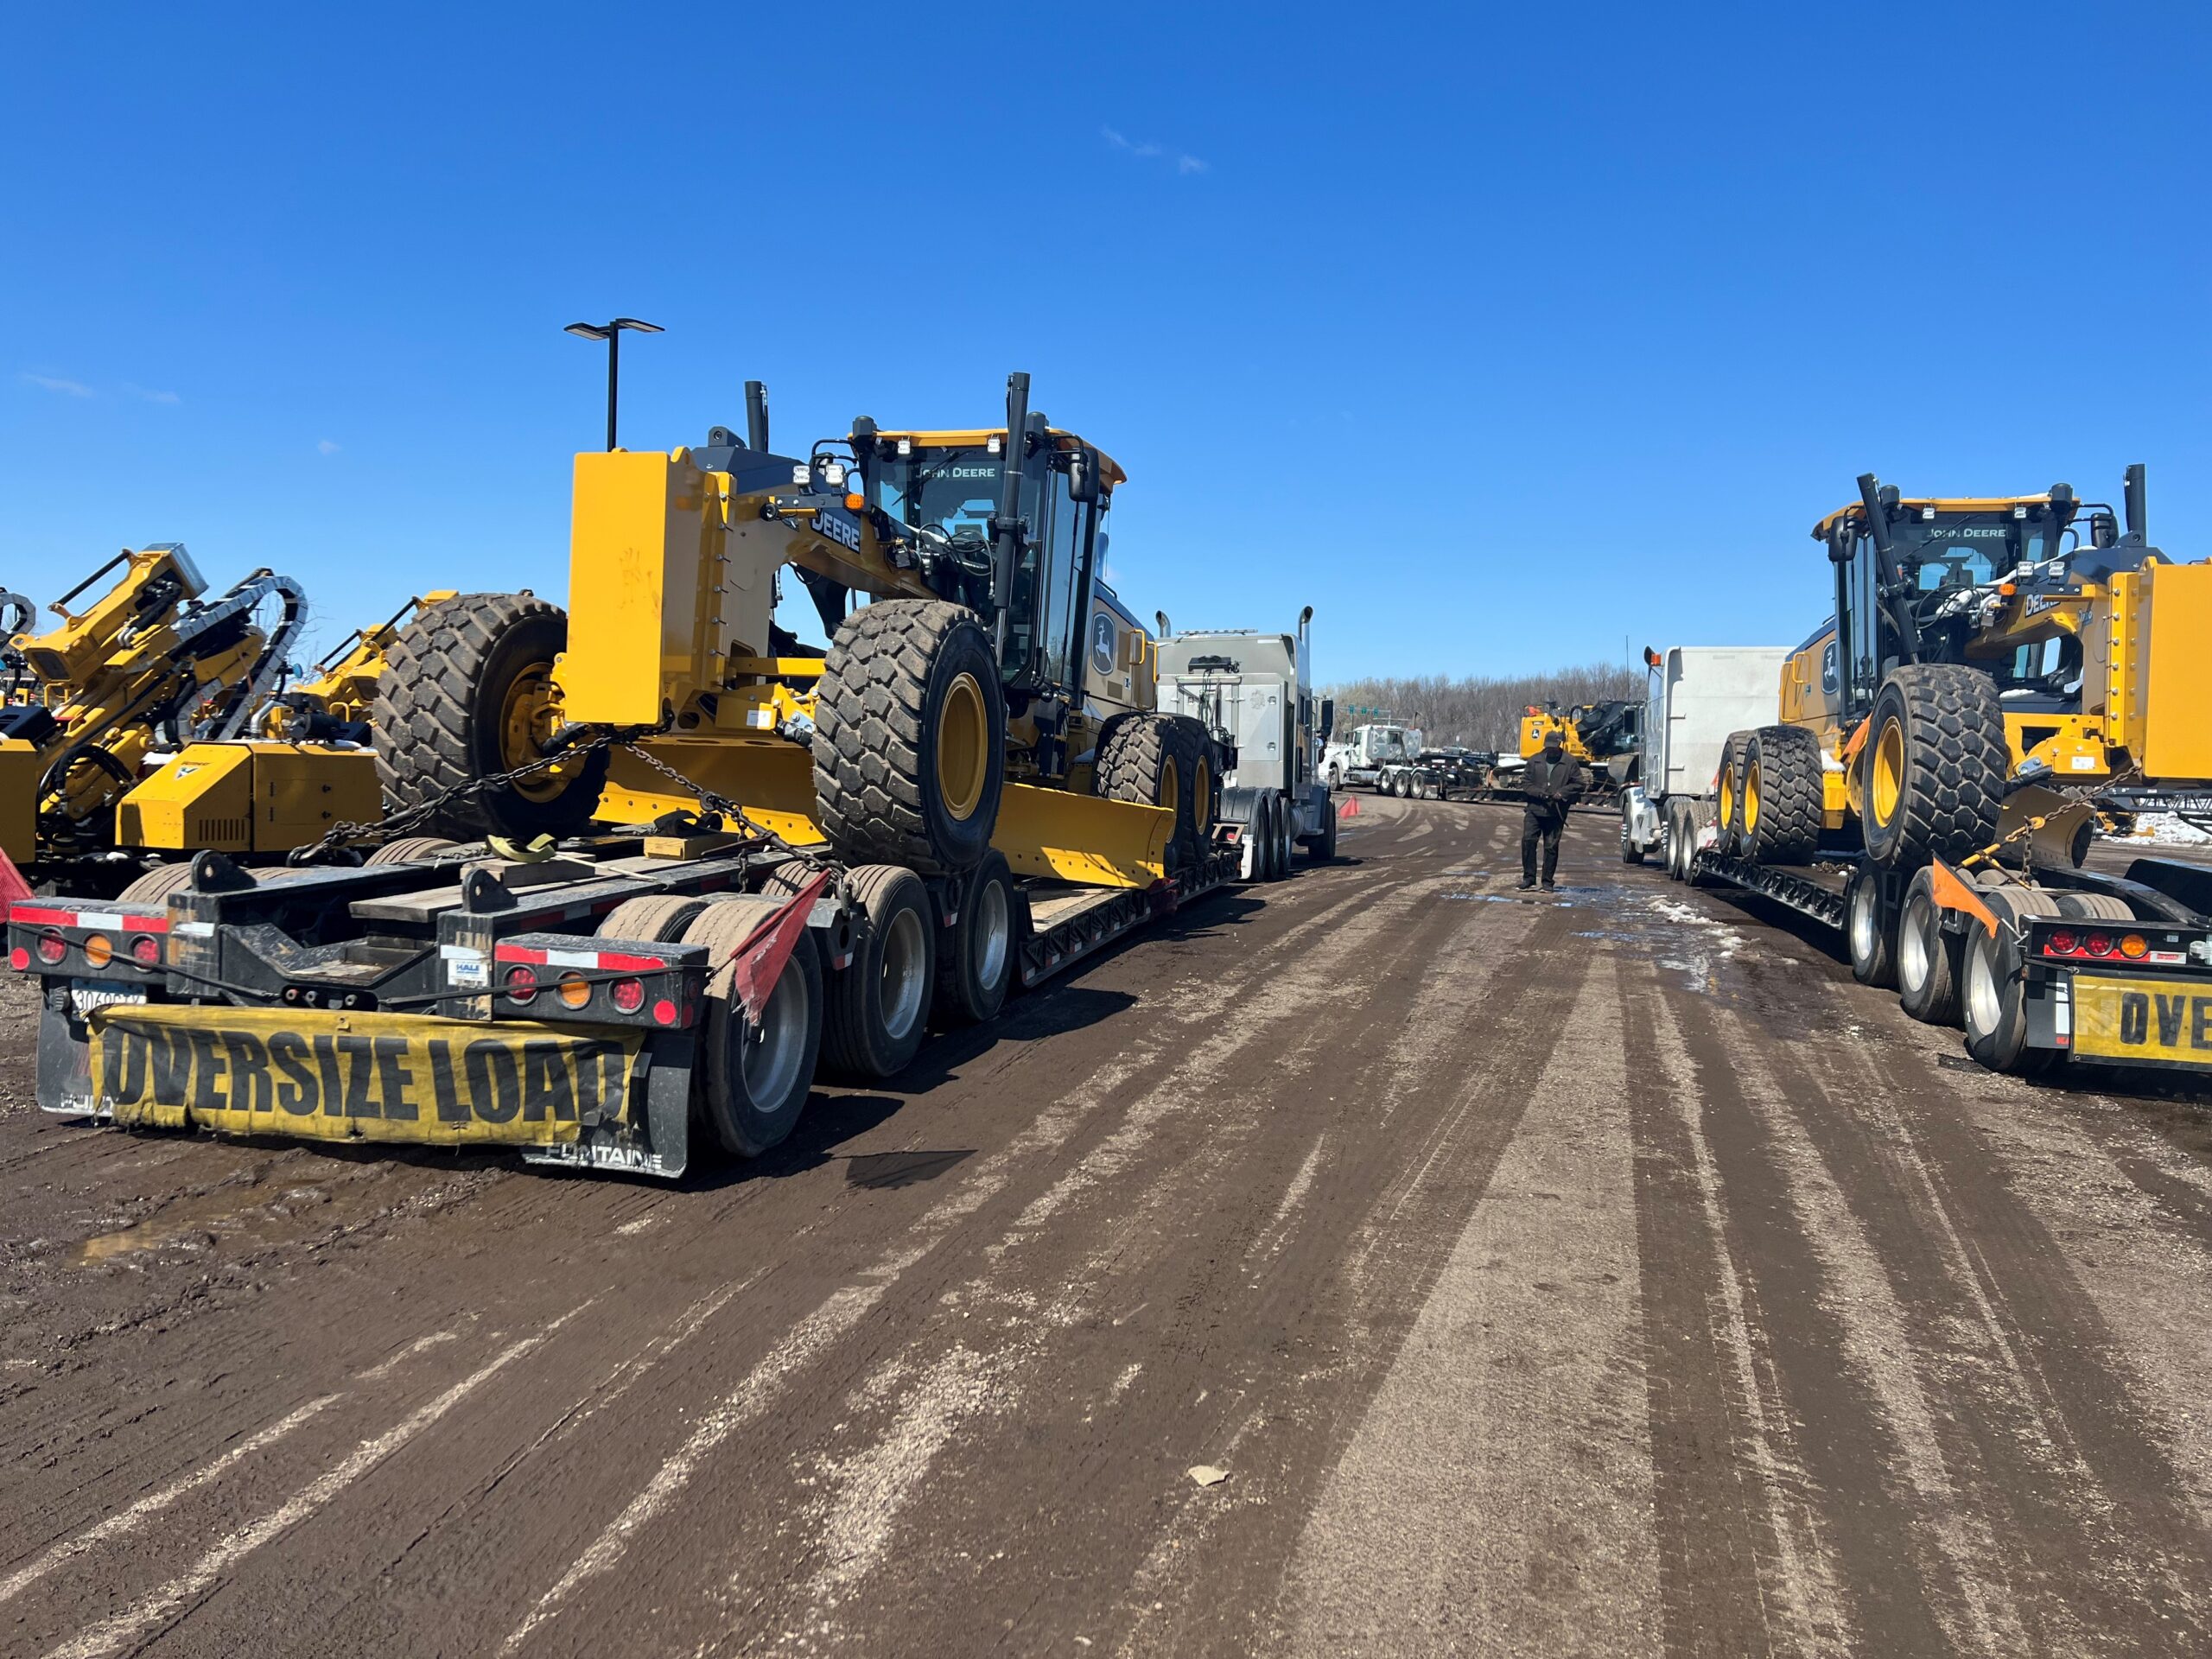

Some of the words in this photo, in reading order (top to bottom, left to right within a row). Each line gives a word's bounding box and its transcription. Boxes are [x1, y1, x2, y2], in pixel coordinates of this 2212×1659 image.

[952, 467, 995, 478] DEERE
[1963, 528, 2006, 538] DEERE
[103, 1021, 419, 1121] OVERSIZE
